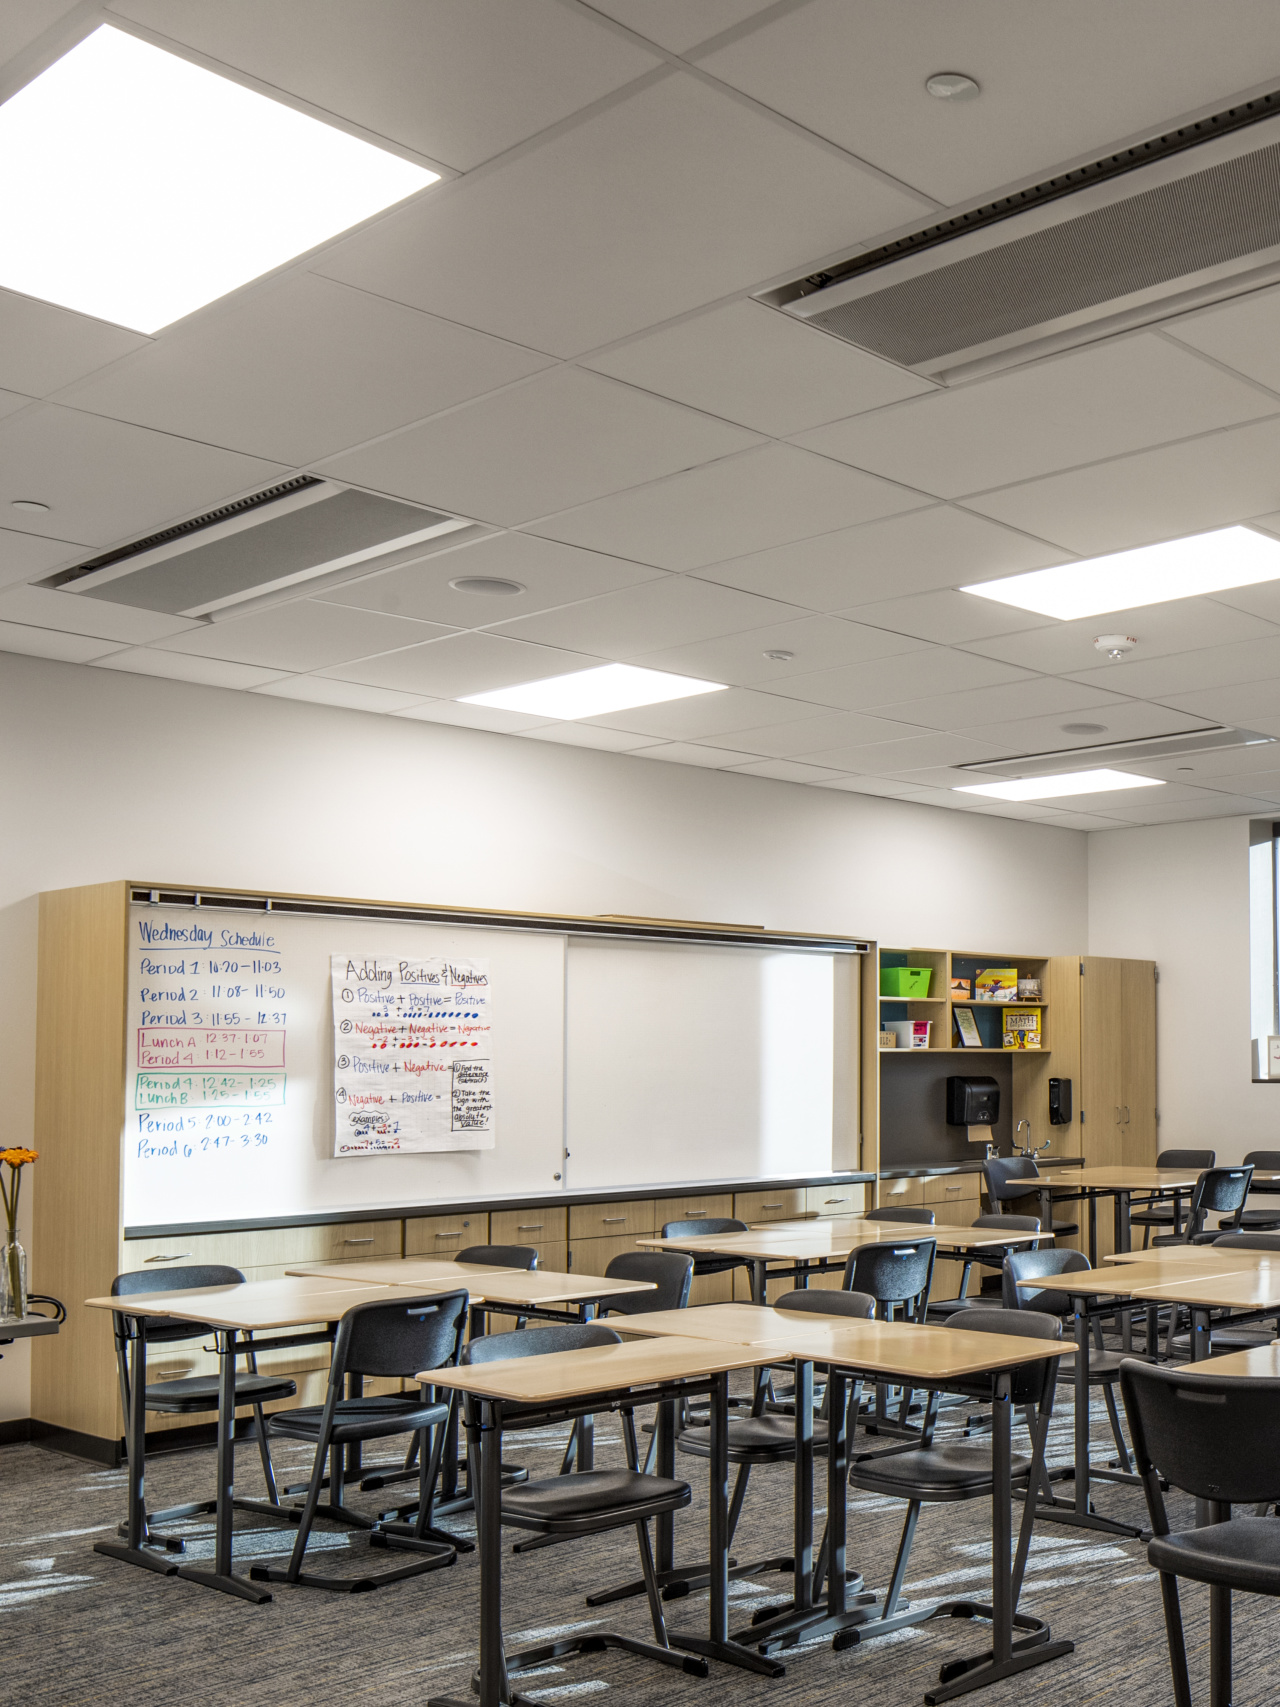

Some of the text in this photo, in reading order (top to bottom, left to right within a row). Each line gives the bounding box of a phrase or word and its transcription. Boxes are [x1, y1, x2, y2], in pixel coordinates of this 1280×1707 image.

[139, 920, 275, 948] Wednesday Schedule
[140, 957, 185, 975] Period
[346, 960, 392, 990] Adding
[400, 961, 441, 984] Positives
[449, 964, 489, 989] Negatives
[140, 987, 186, 1003] Period
[357, 986, 396, 1004] Positive
[408, 993, 444, 1007] Positive
[455, 991, 486, 1006] Positive
[141, 1010, 187, 1026] Period
[141, 1032, 184, 1048] Lunch
[355, 1022, 399, 1040] Negative
[408, 1023, 449, 1038] Negative
[141, 1050, 180, 1065] Period
[352, 1055, 390, 1074] Positive
[403, 1059, 447, 1077] Negative
[140, 1076, 181, 1090] Period
[140, 1092, 178, 1105] Lunch
[348, 1093, 386, 1109] Negative
[401, 1090, 434, 1104] Positive
[138, 1112, 184, 1133] Period
[138, 1138, 178, 1159] Period
